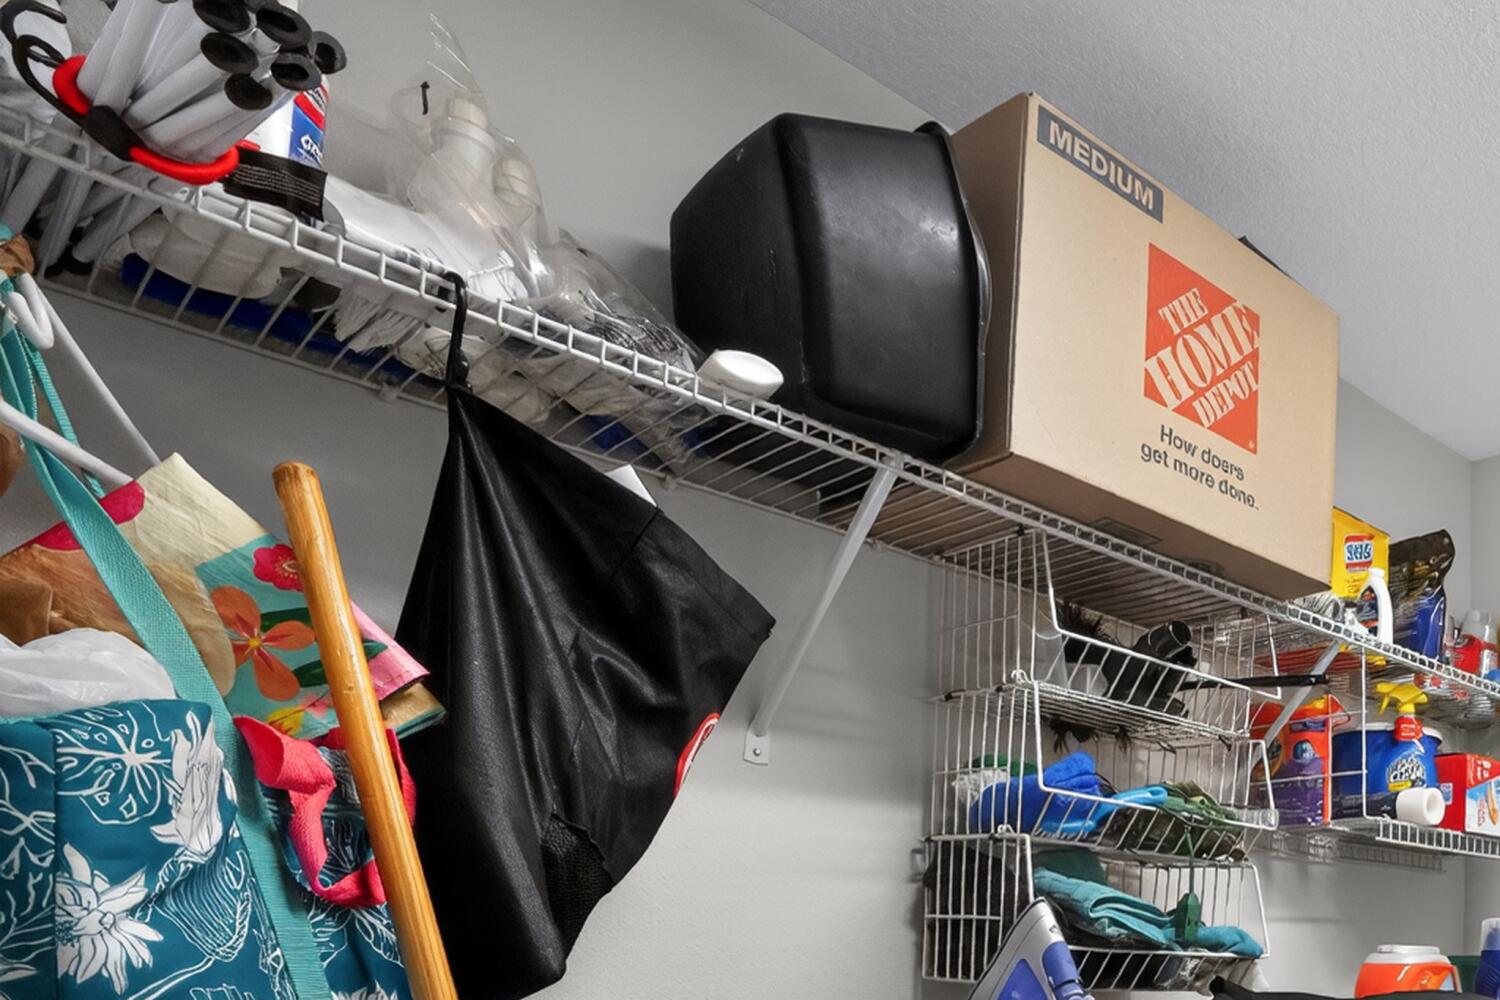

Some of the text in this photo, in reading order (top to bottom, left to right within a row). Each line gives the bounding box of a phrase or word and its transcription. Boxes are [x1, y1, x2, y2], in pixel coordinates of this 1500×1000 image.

[1049, 119, 1154, 211] MEDIUM
[1157, 287, 1209, 336] THE
[1144, 302, 1260, 408] HOME
[1191, 361, 1259, 428] DEPOT
[1140, 443, 1169, 468] get
[1173, 459, 1216, 489] more
[1160, 424, 1245, 481] How doers
